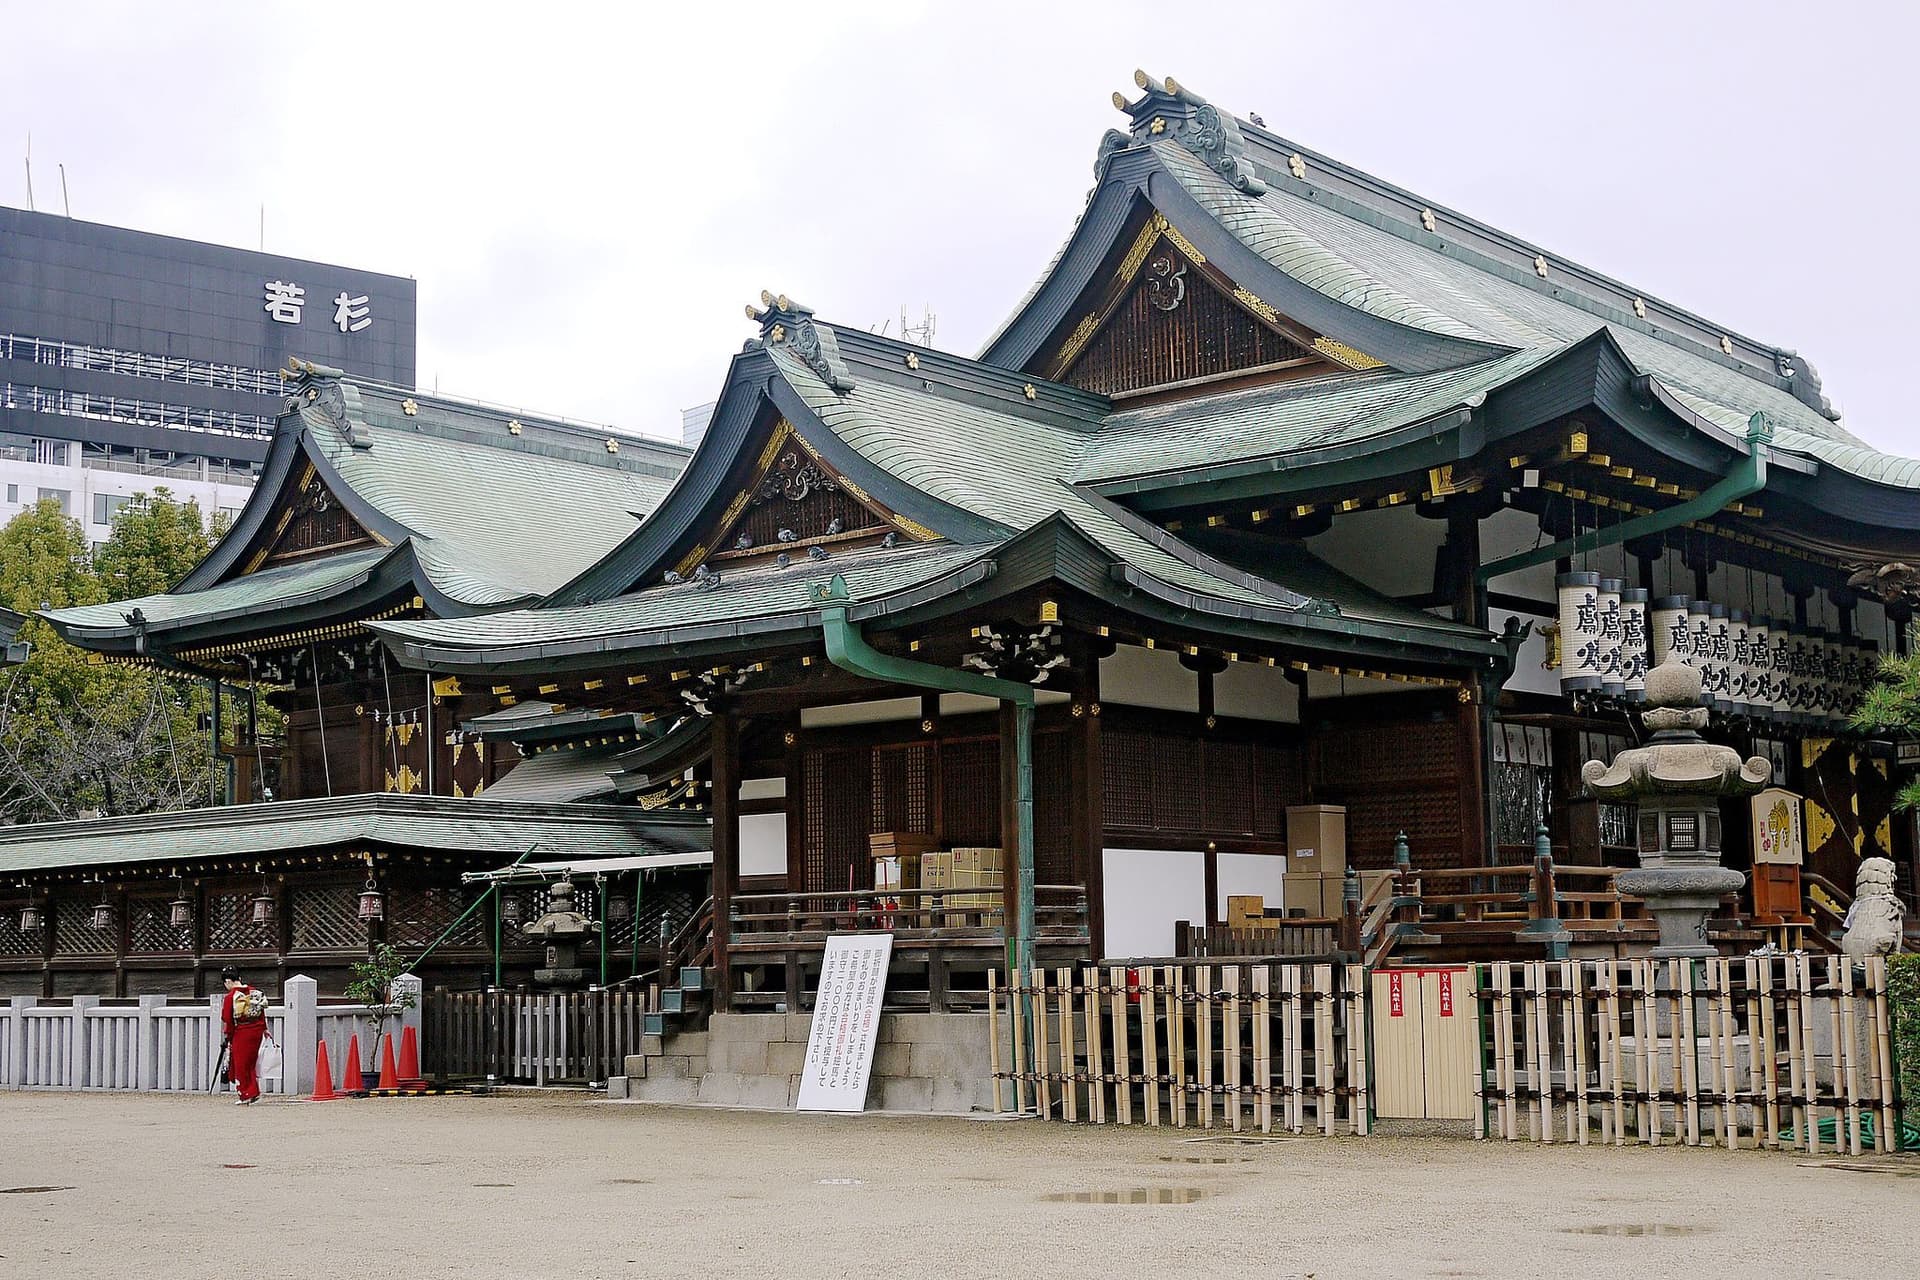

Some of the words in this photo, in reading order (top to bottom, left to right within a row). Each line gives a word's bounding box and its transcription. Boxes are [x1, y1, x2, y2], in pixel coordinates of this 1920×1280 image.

[265, 280, 372, 333] 若杉
[1392, 974, 1400, 1011] 立入禁止
[1442, 974, 1450, 1011] 立入禁止
